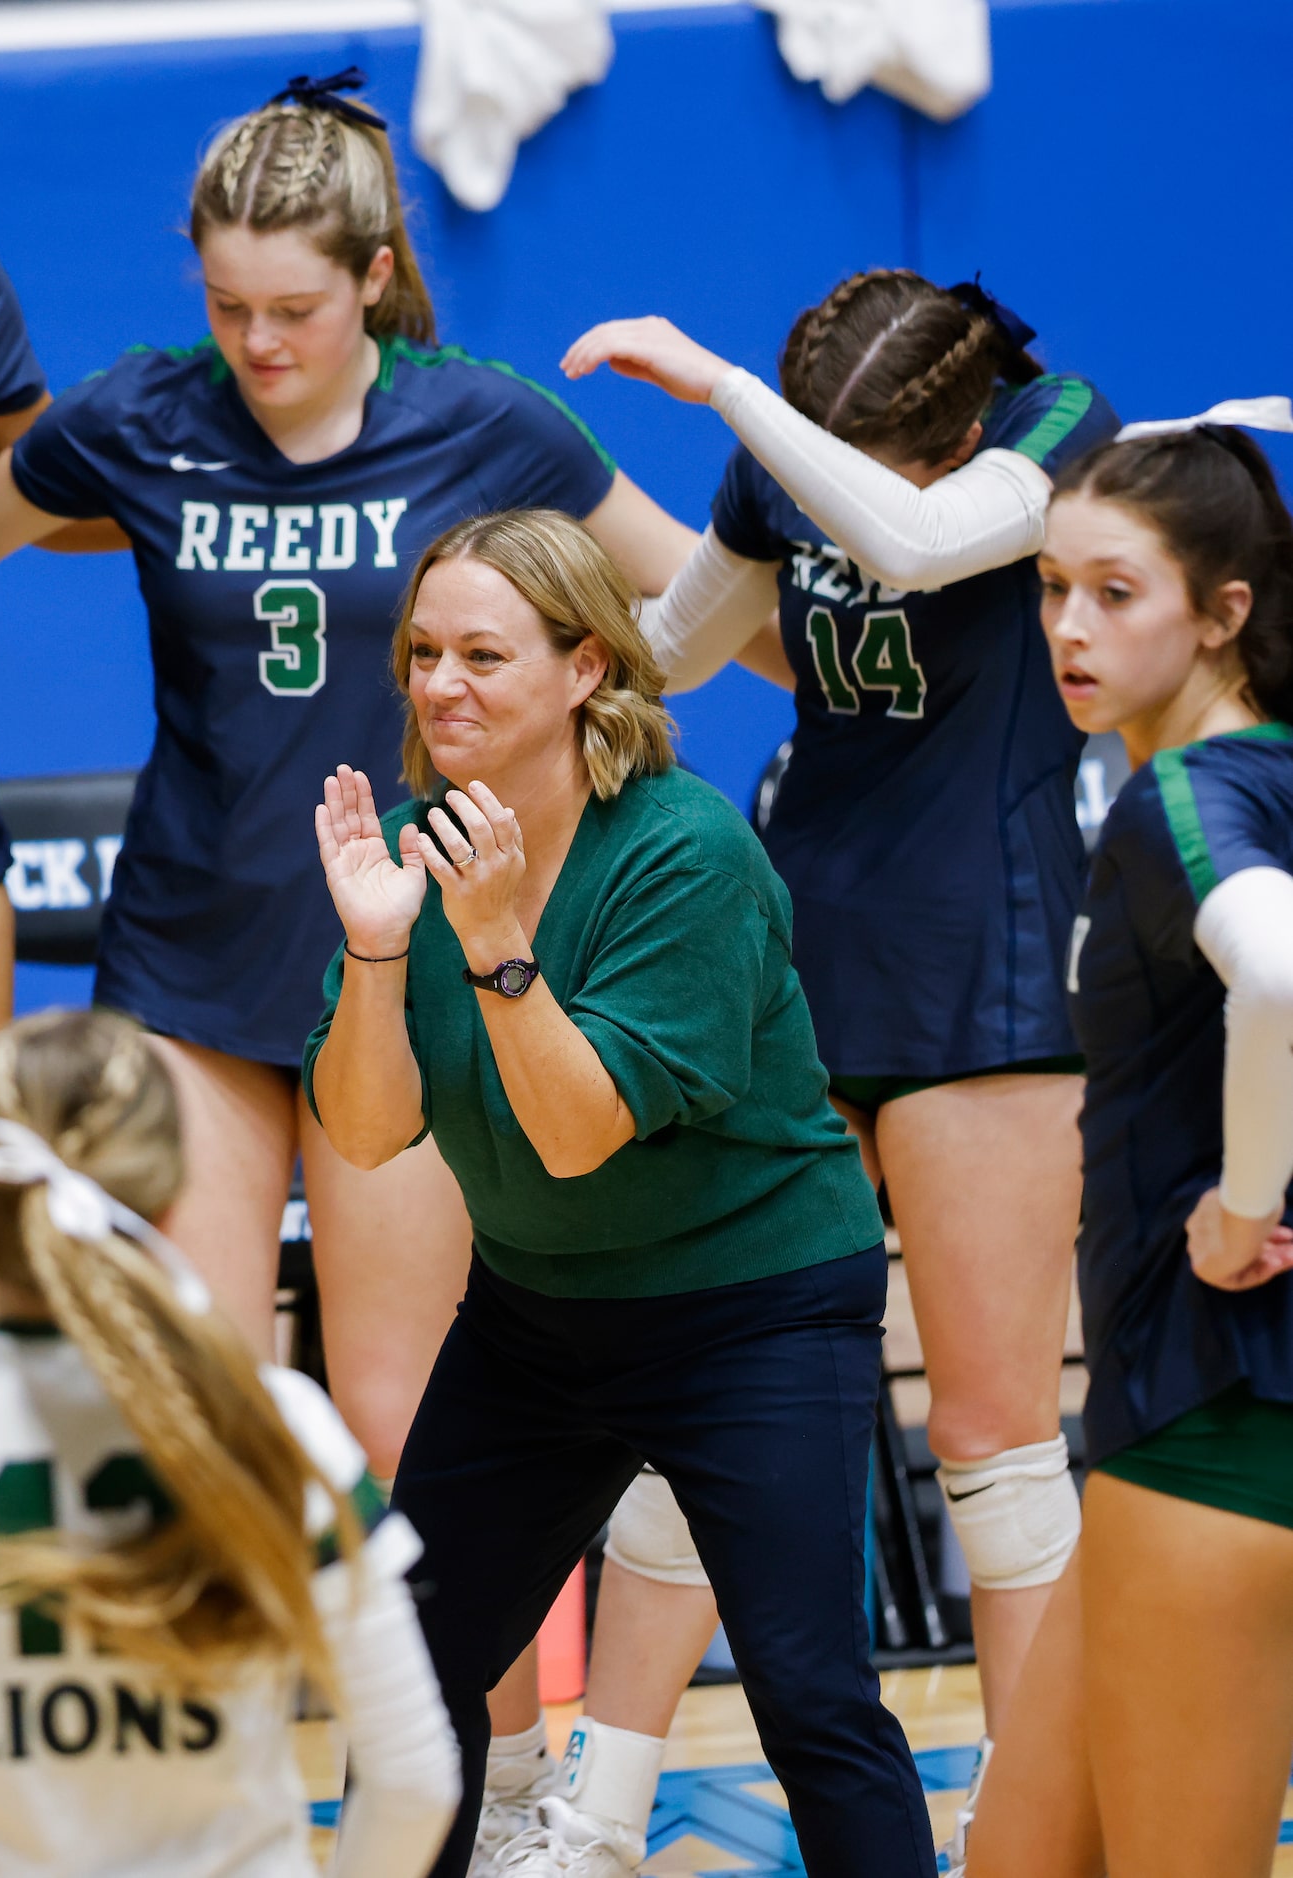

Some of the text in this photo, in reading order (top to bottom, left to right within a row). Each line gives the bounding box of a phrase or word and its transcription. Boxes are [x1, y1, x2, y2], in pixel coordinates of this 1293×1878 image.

[176, 498, 409, 572] REEDY
[253, 579, 327, 697] 3
[806, 604, 928, 720] 14
